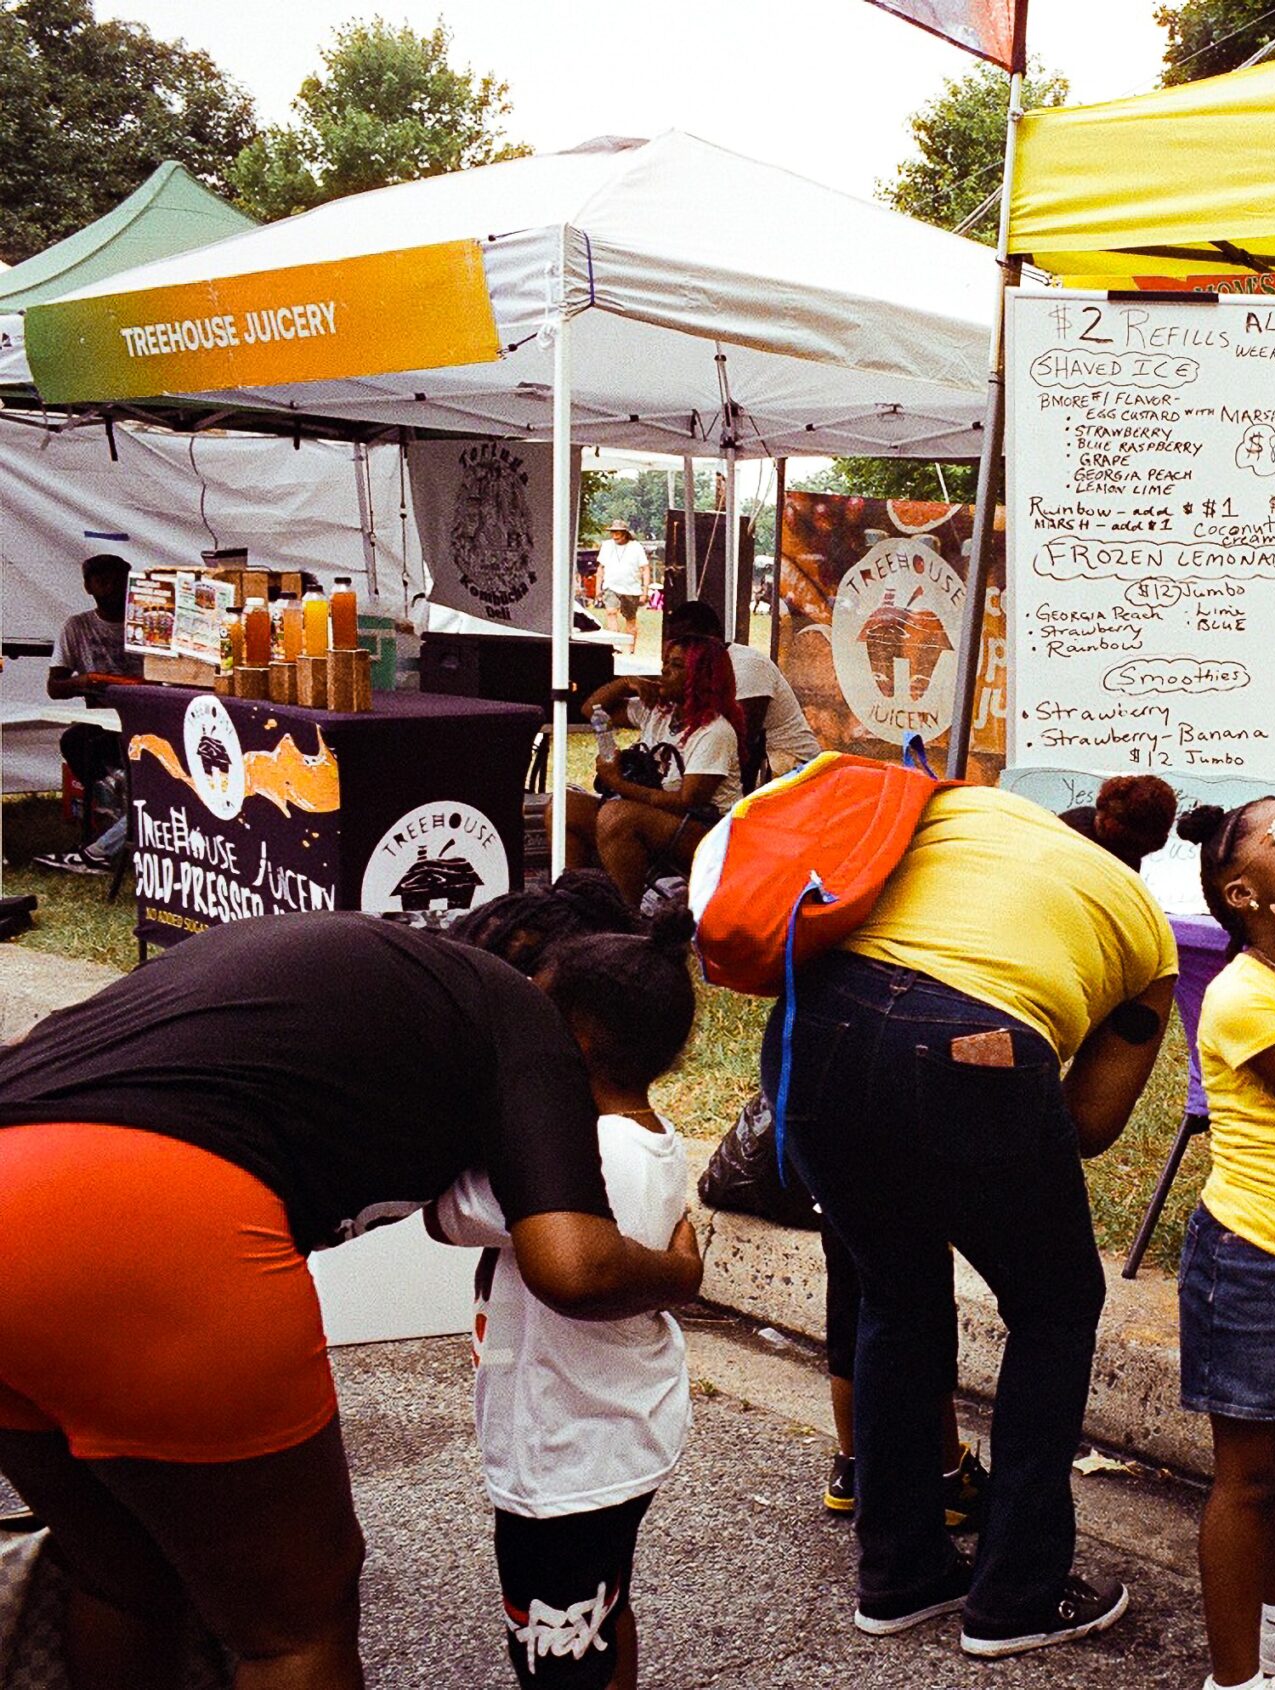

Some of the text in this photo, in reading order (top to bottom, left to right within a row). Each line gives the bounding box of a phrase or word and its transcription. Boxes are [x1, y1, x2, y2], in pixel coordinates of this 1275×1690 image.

[120, 300, 337, 358] TREEHOUSE JUICERY
[1049, 305, 1113, 343] $2
[1120, 308, 1230, 349] REFILLS
[1037, 355, 1193, 379] SHAVED ICE
[1075, 424, 1172, 441] STRAWBERRY
[1077, 438, 1203, 457] BLUE RASPBERRY
[1079, 453, 1130, 467] GRAPE
[1074, 468, 1193, 482] GEORGIA PEACH
[1076, 481, 1176, 495] LEMON LIME
[1043, 543, 1163, 569] FROZEN
[846, 552, 966, 608] TREEHOUSE
[1180, 582, 1246, 598] Jumbo
[1036, 603, 1106, 622] GEORGIA
[1040, 624, 1143, 642] Strawberry
[1047, 638, 1143, 657] Rainbow
[1118, 667, 1239, 686] Smoothies
[1129, 748, 1245, 767] $12 Jumbo
[382, 812, 497, 857] TREEHOUSE
